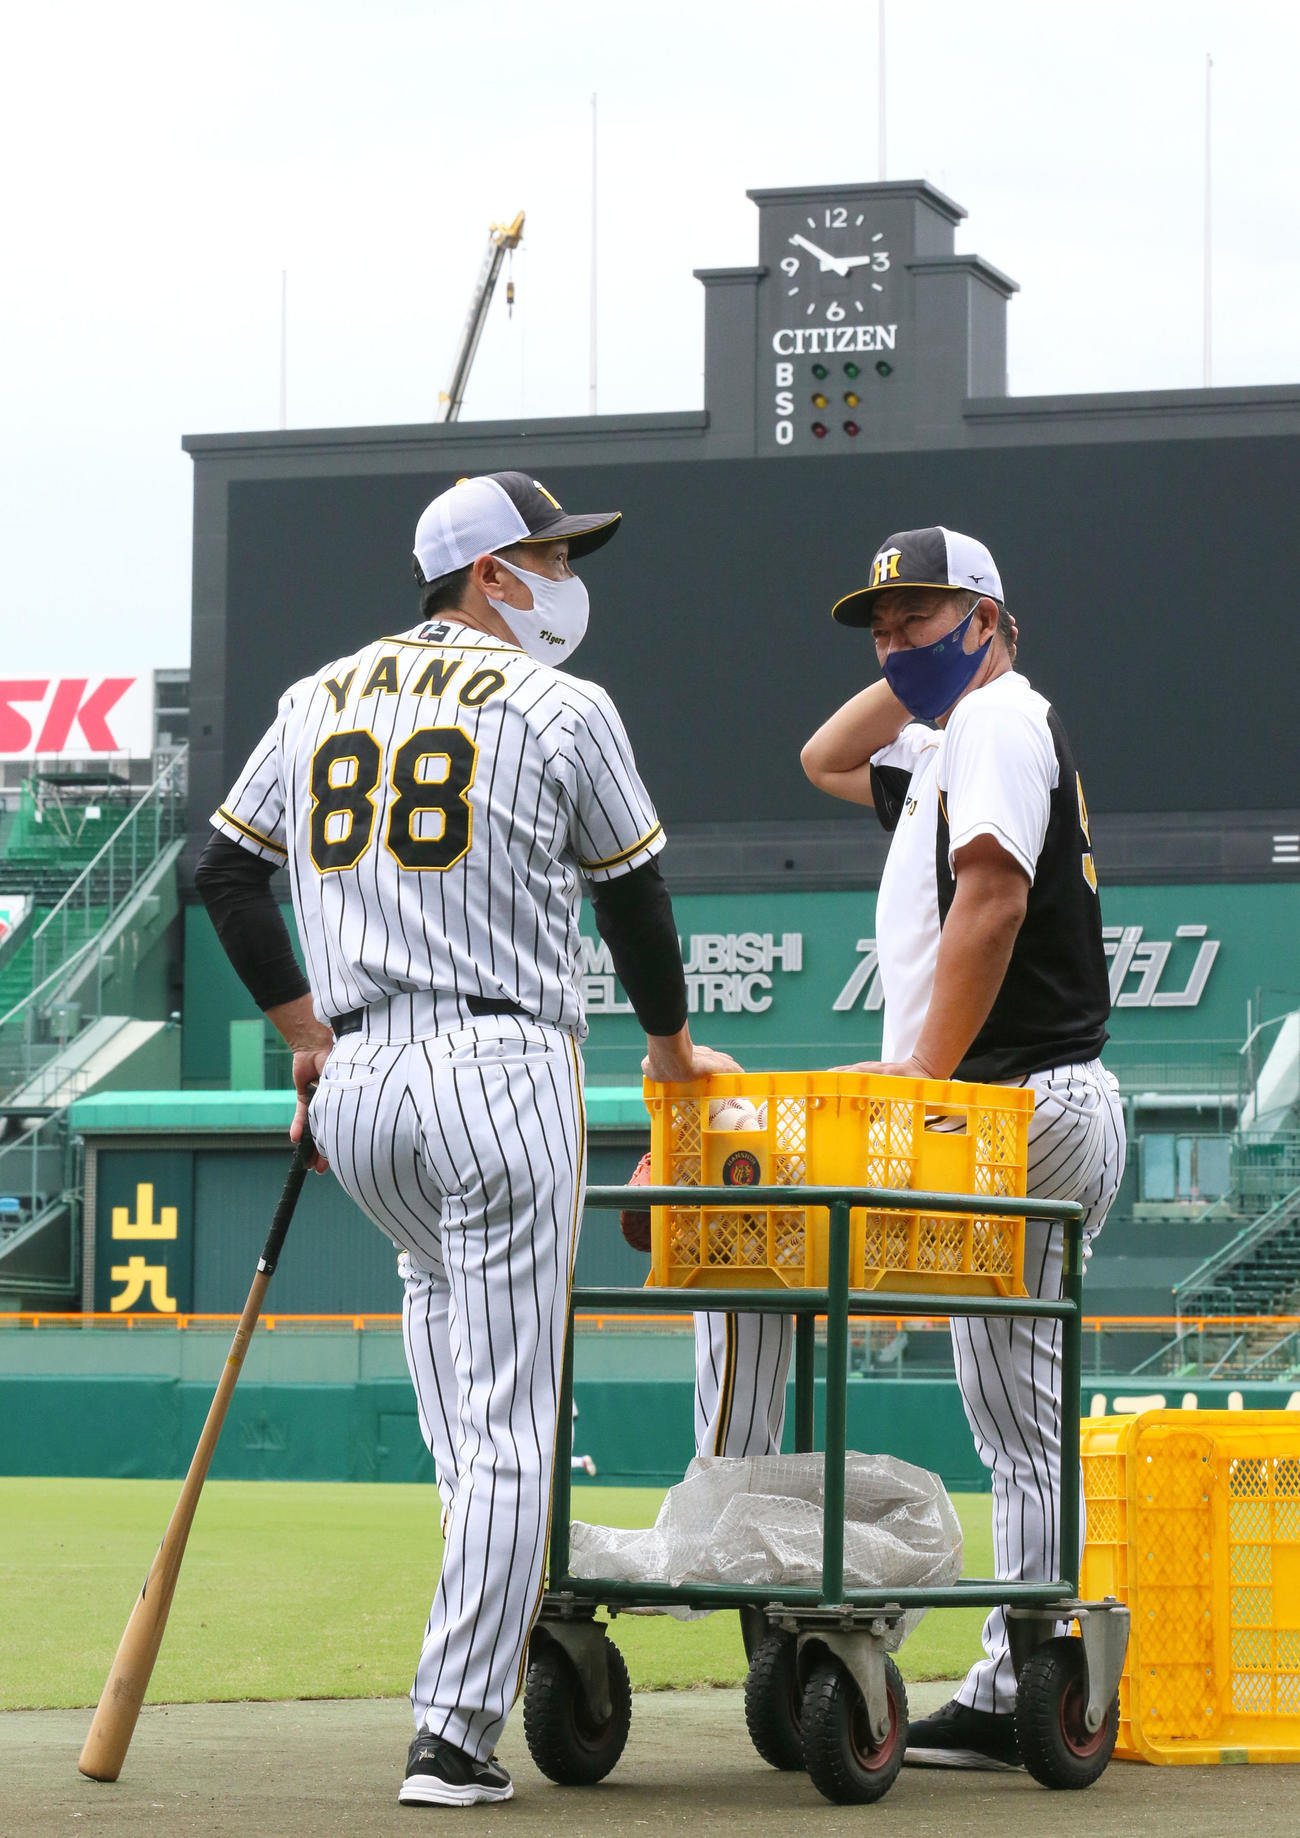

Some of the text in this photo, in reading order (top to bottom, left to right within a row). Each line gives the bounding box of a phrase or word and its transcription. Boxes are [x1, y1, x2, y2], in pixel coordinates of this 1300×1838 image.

[825, 208, 848, 228] 12
[780, 258, 800, 277] 9
[872, 252, 891, 272] 3
[826, 302, 846, 321] 6
[772, 325, 897, 355] CITIZEN
[776, 363, 794, 387] B
[775, 393, 794, 416] S
[539, 629, 566, 645] Tigers
[324, 656, 506, 714] YANO
[310, 726, 479, 874] 88
[110, 1182, 178, 1313] 山九
